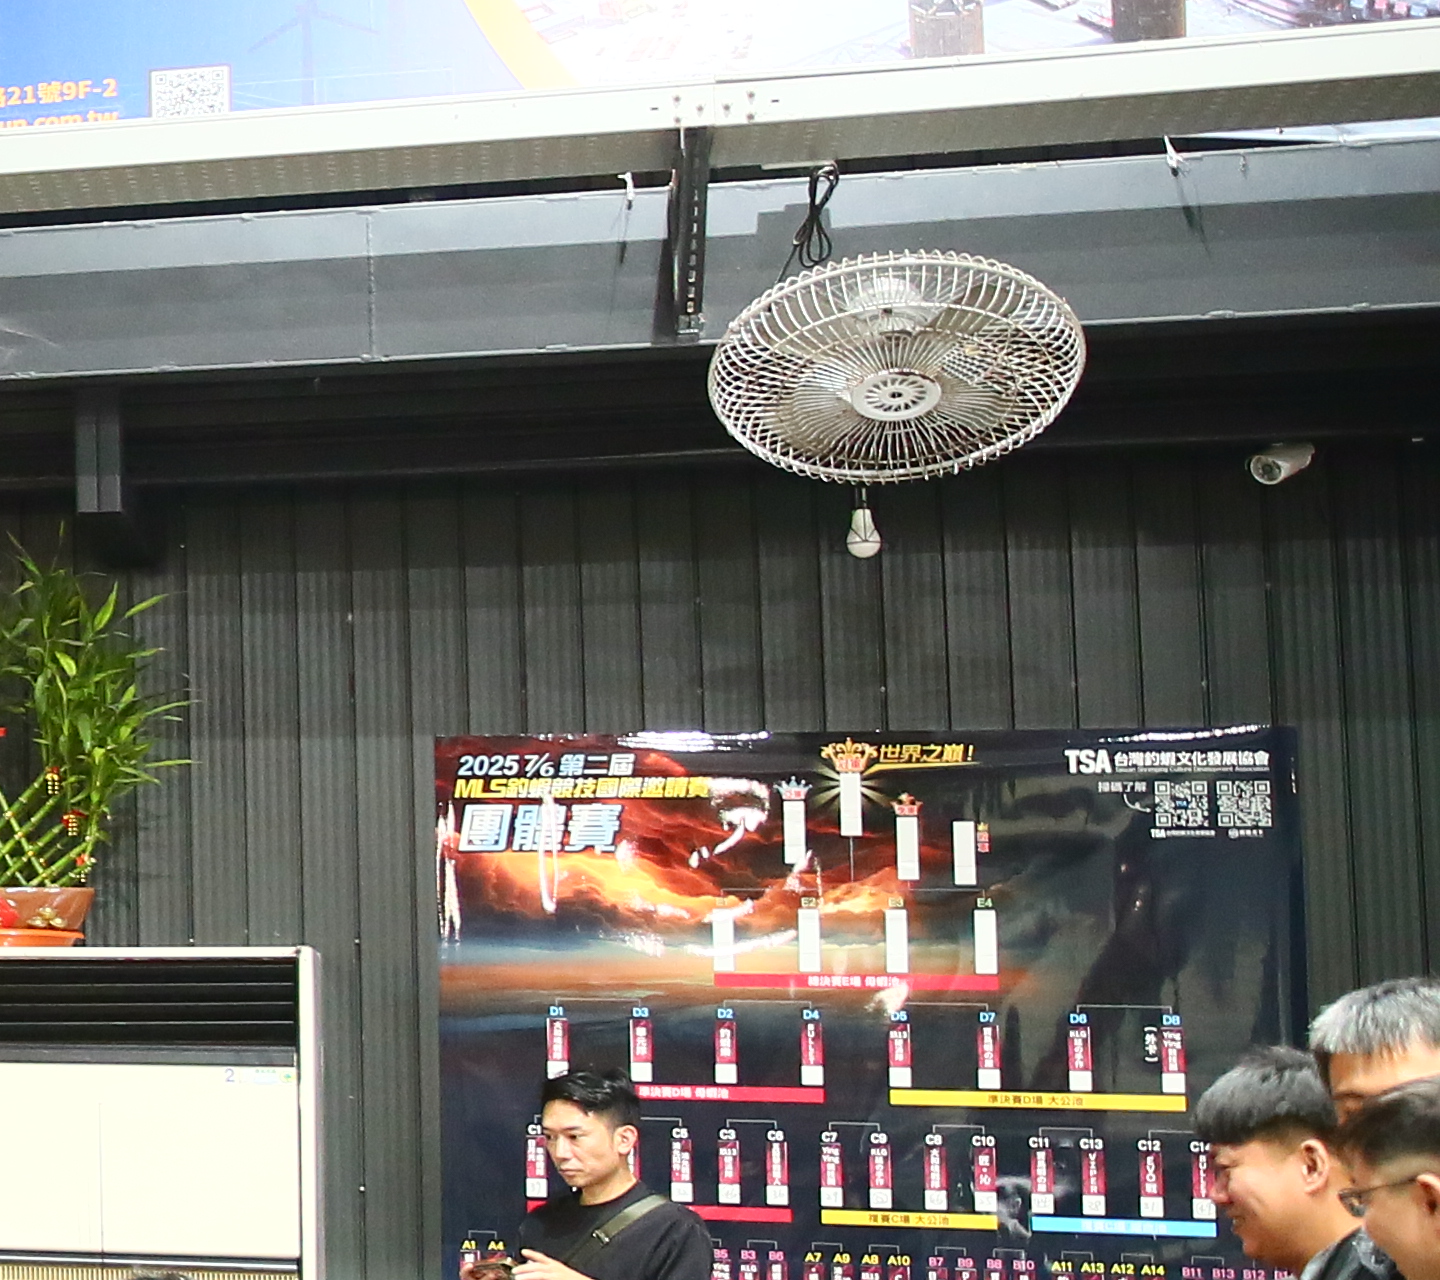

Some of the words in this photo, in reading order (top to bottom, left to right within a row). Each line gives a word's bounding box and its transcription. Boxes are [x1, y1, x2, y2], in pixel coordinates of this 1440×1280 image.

[457, 754, 521, 777] 2025
[558, 753, 636, 777] 第二屆
[1064, 749, 1113, 774] TSA
[457, 802, 624, 853] 團體賽
[976, 897, 993, 908] E4
[549, 1006, 564, 1017] D1
[632, 1006, 650, 1018] D3
[716, 1008, 734, 1019] D2
[802, 1009, 821, 1021] D4
[979, 1011, 997, 1023] D7
[719, 1129, 737, 1140] C3
[821, 1131, 839, 1143] C7
[971, 1135, 996, 1147] C10
[1028, 1136, 1050, 1148] C11
[1079, 1138, 1103, 1150] C13
[1137, 1140, 1162, 1151] C12
[462, 1240, 477, 1250] A1
[487, 1240, 505, 1251] A4
[804, 1252, 822, 1263] A7
[886, 1255, 911, 1267] A10
[928, 1256, 945, 1267] B7
[1051, 1261, 1073, 1272] A11
[1080, 1262, 1105, 1273] A13
[1110, 1263, 1135, 1275] A12
[1140, 1264, 1166, 1276] A14
[1181, 1266, 1203, 1278] B11
[1212, 1268, 1236, 1279] B13
[1242, 1269, 1266, 1280] B12
